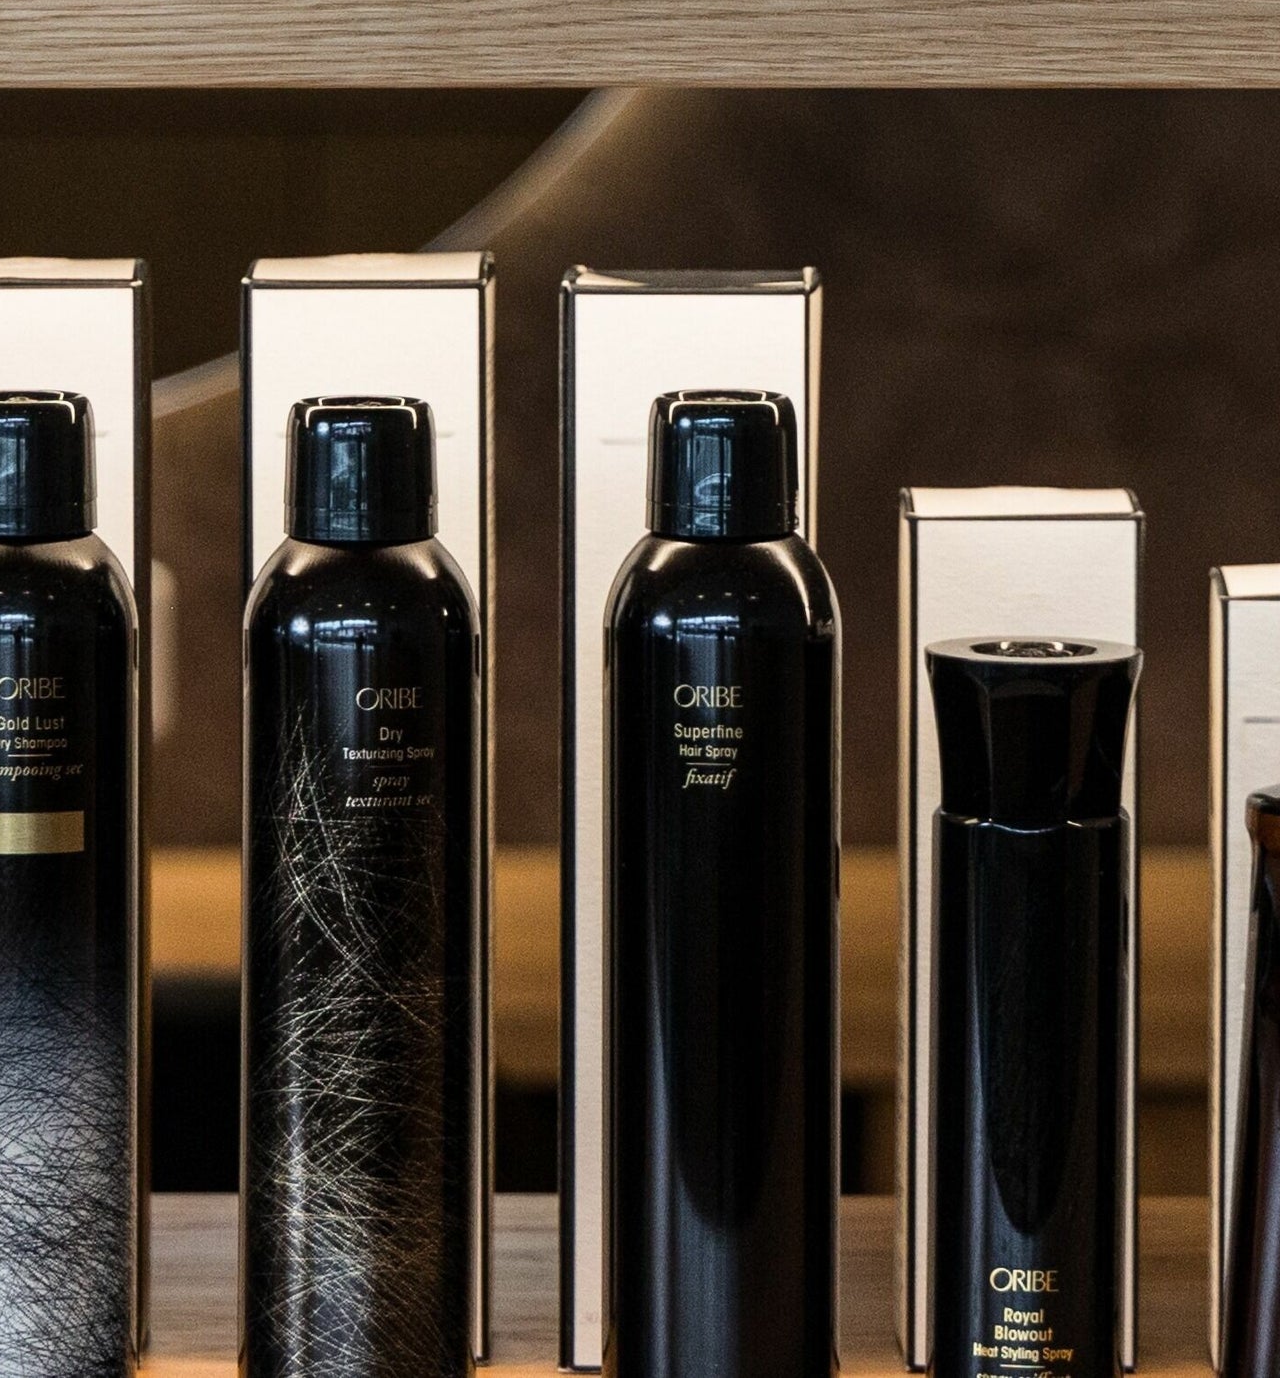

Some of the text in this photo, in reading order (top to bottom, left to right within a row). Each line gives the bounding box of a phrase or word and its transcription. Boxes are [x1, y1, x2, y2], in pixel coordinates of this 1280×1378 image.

[355, 687, 424, 711] ORIBE
[674, 684, 744, 708] ORIBE
[35, 716, 65, 730] Lust
[379, 726, 403, 743] Dry
[674, 723, 744, 742] Superfine
[14, 736, 68, 750] Shampoo
[679, 744, 738, 760] Hair Spray
[342, 746, 435, 762] Texturizing Spray
[372, 775, 410, 792] spray
[682, 768, 737, 790] fixatif
[989, 1267, 1060, 1293] ORIBE
[1003, 1307, 1045, 1326] Royal
[994, 1324, 1054, 1342] Blowout
[973, 1342, 1074, 1363] Heat Styling Spray
